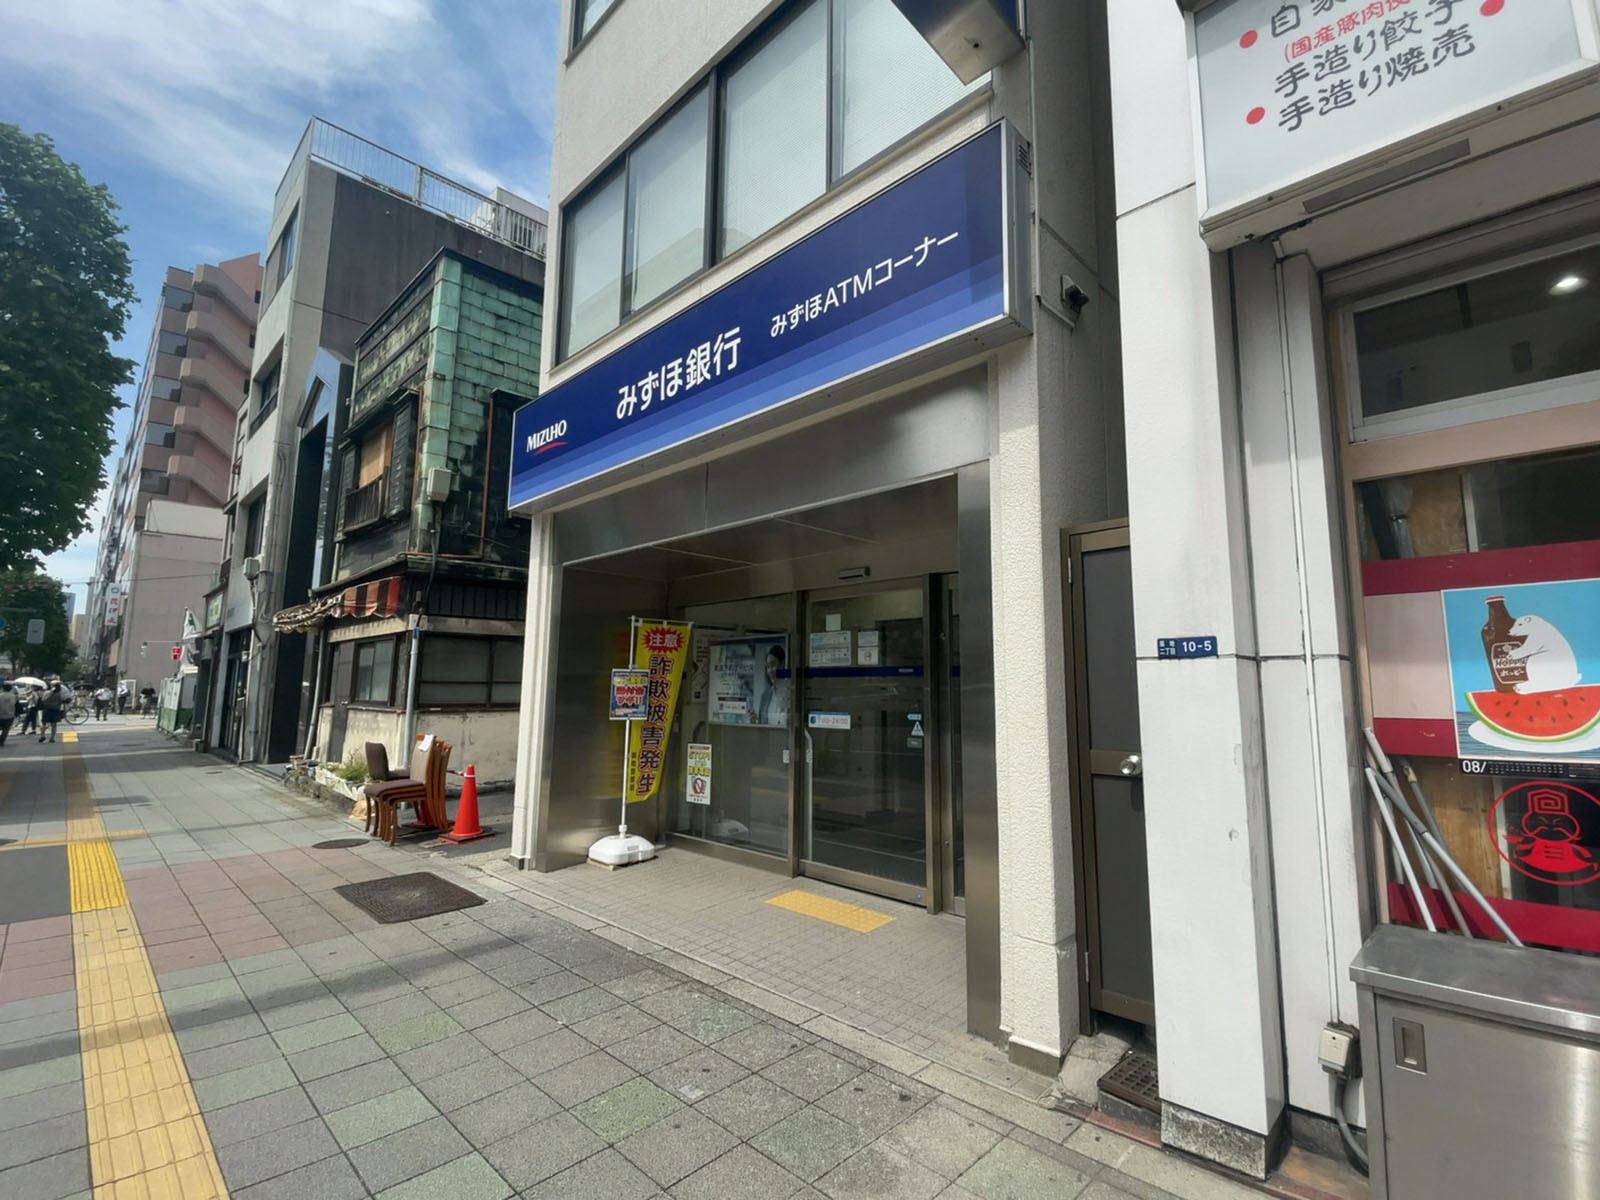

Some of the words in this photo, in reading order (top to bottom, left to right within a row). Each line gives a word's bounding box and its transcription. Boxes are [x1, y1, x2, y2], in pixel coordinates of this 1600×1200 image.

[1275, 0, 1464, 98] 手造り餃子
[1279, 24, 1475, 132] 手造り焼売
[526, 419, 568, 452] MIZUHO
[616, 326, 742, 420] みずほ銀行
[770, 231, 959, 338] みずほATMコーナー
[650, 632, 678, 648] 注意
[1182, 640, 1212, 653] 10-5
[637, 655, 674, 794] 詐欺被害発生
